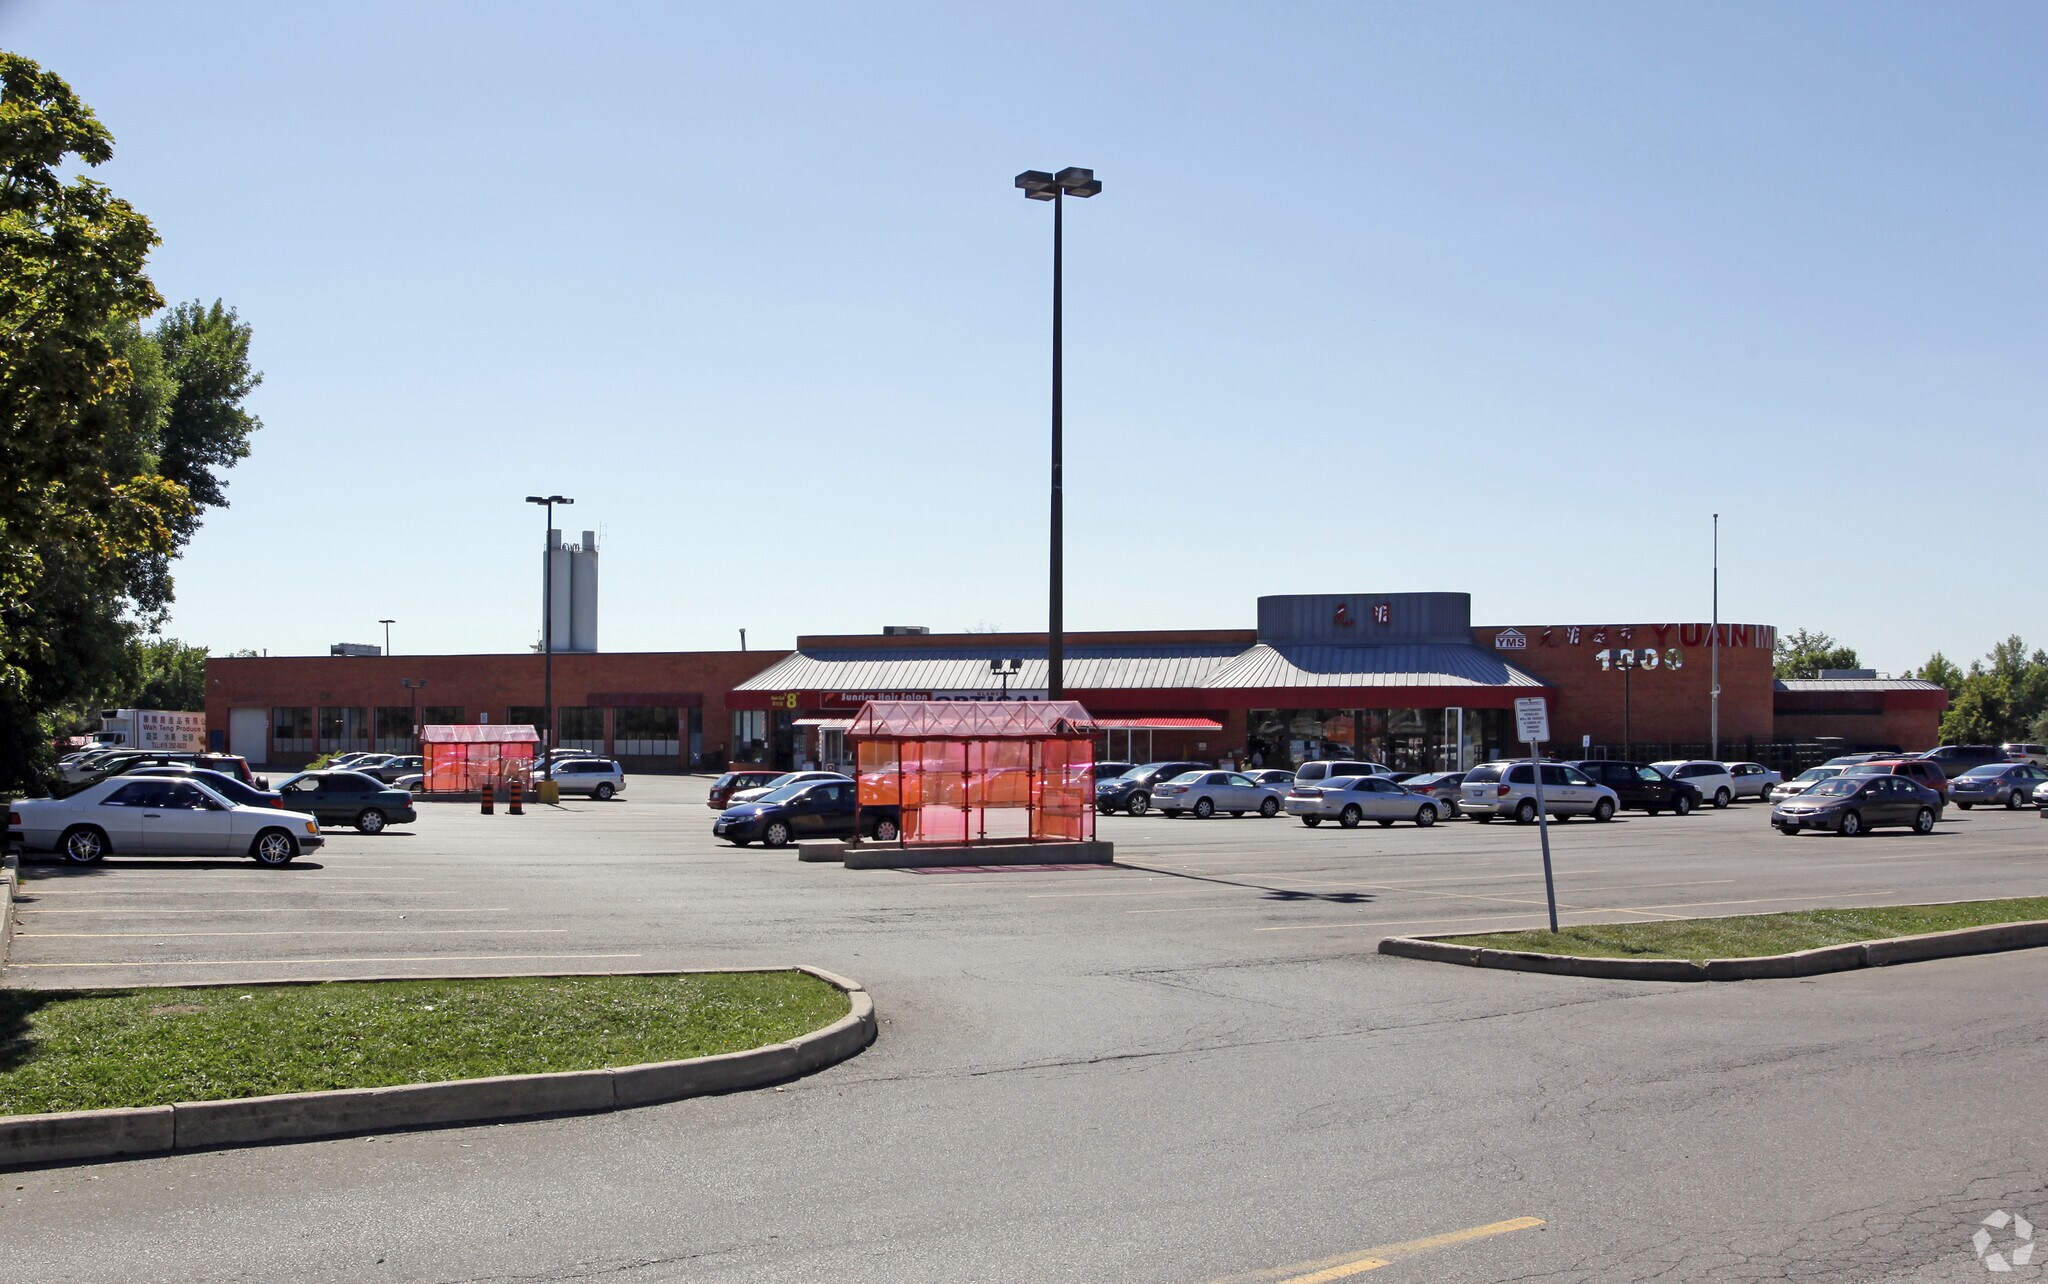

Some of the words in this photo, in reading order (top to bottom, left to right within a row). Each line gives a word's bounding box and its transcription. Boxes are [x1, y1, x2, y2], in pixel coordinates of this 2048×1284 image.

[1651, 623, 1748, 648] YUAN
[1497, 638, 1525, 647] YMS
[841, 692, 876, 701] Sunrise
[878, 692, 899, 701] Hair
[901, 692, 928, 701] Salon
